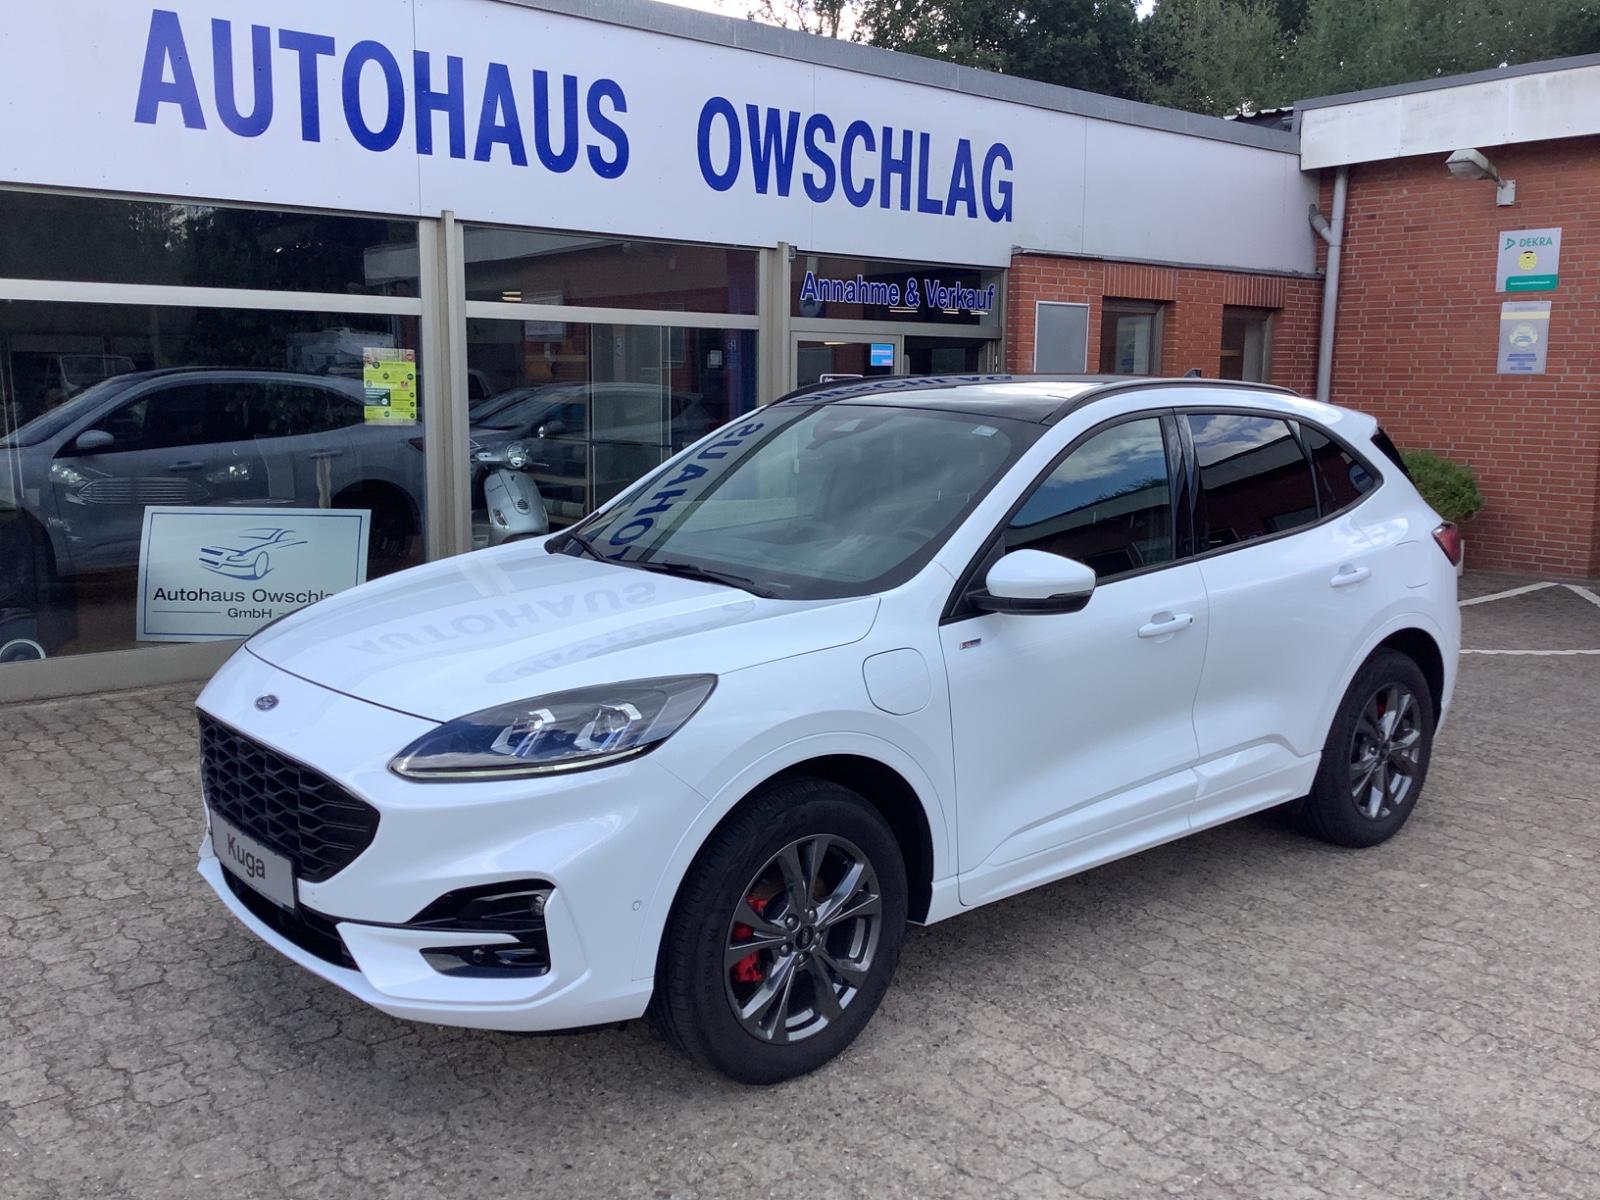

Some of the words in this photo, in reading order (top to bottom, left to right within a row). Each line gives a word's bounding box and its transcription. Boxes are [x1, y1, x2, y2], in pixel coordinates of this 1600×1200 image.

[134, 9, 630, 180] AUTOHAUS
[697, 97, 1014, 223] OWSCHLAG
[1519, 237, 1553, 248] DEKRA
[801, 270, 900, 306] Annahme
[904, 277, 920, 308] &
[924, 278, 995, 311] Verkauf
[153, 587, 246, 602] Autohaus
[226, 607, 273, 619] GmbH
[226, 831, 266, 885] Kuga
